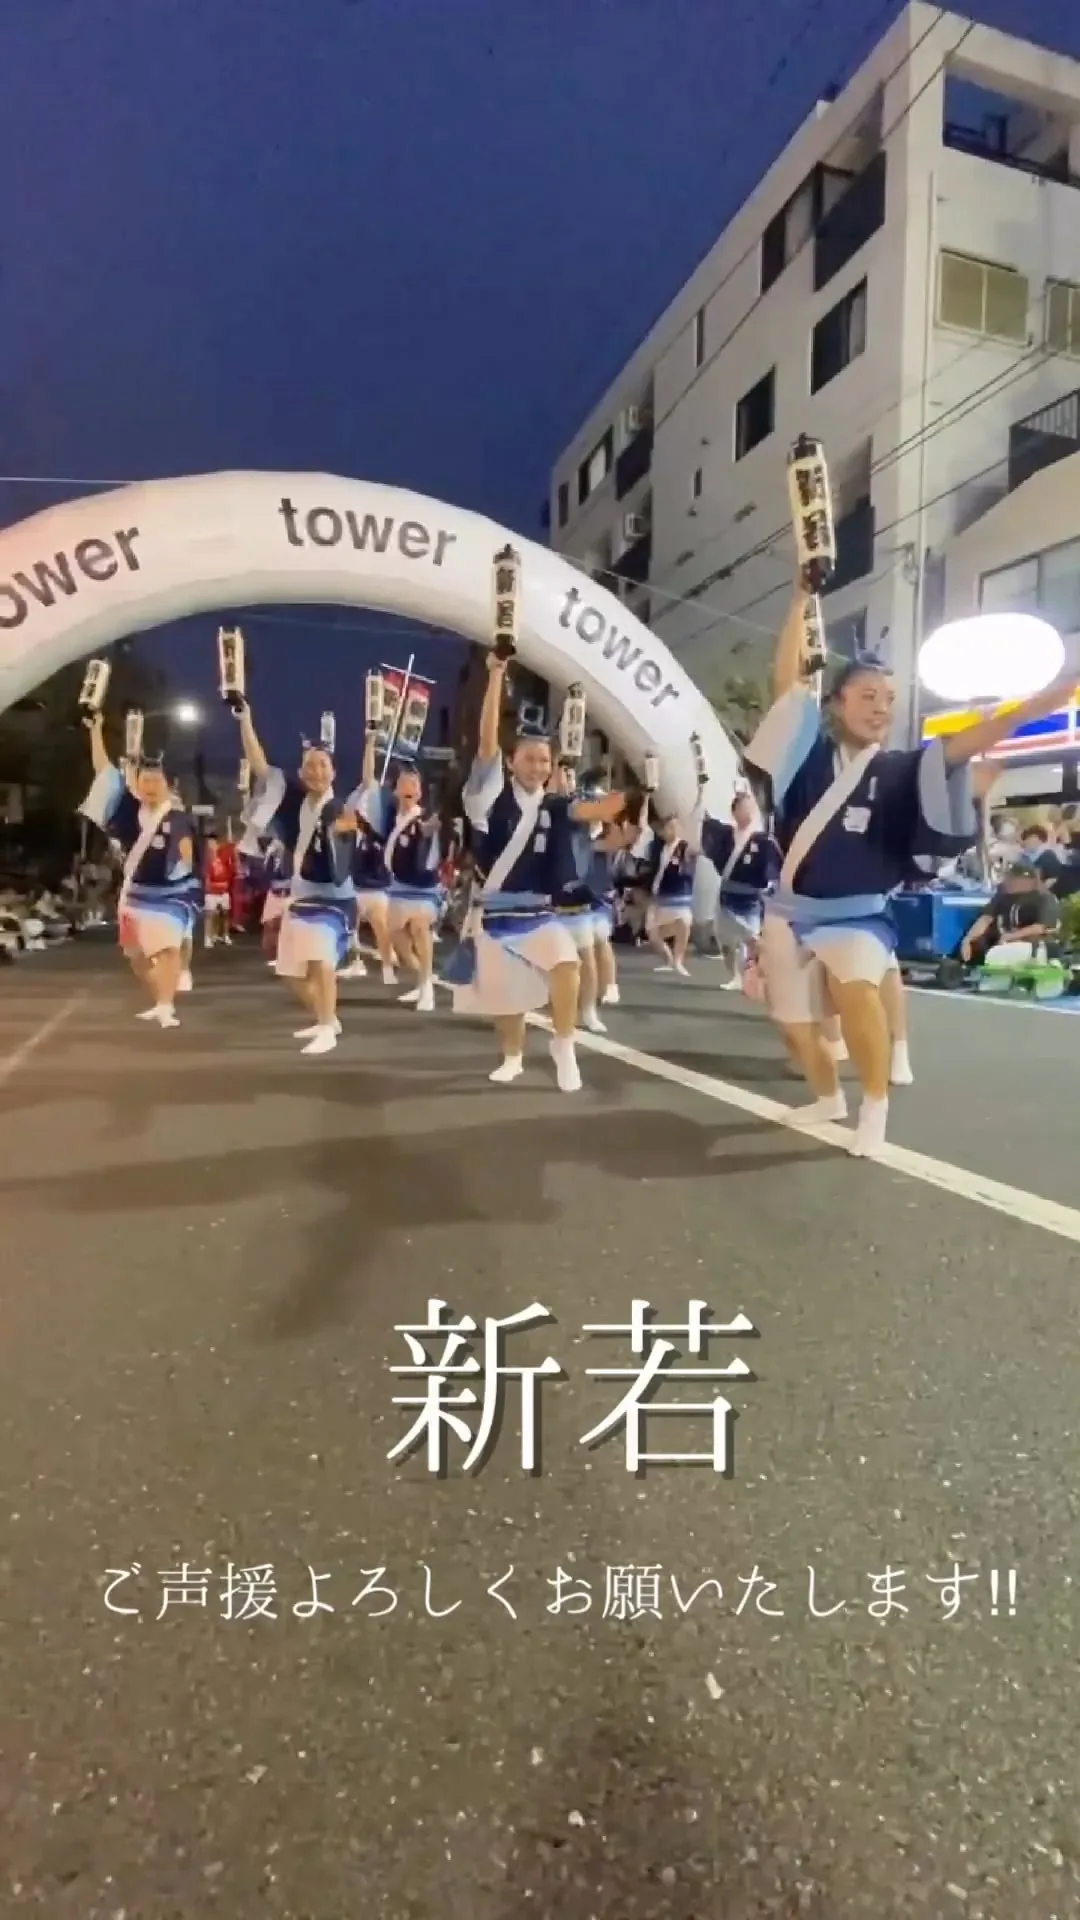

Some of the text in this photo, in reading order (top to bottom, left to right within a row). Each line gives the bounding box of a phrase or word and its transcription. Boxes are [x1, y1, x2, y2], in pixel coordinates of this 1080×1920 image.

[0, 527, 140, 630] ower
[278, 497, 457, 566] tower
[558, 587, 680, 708] tower
